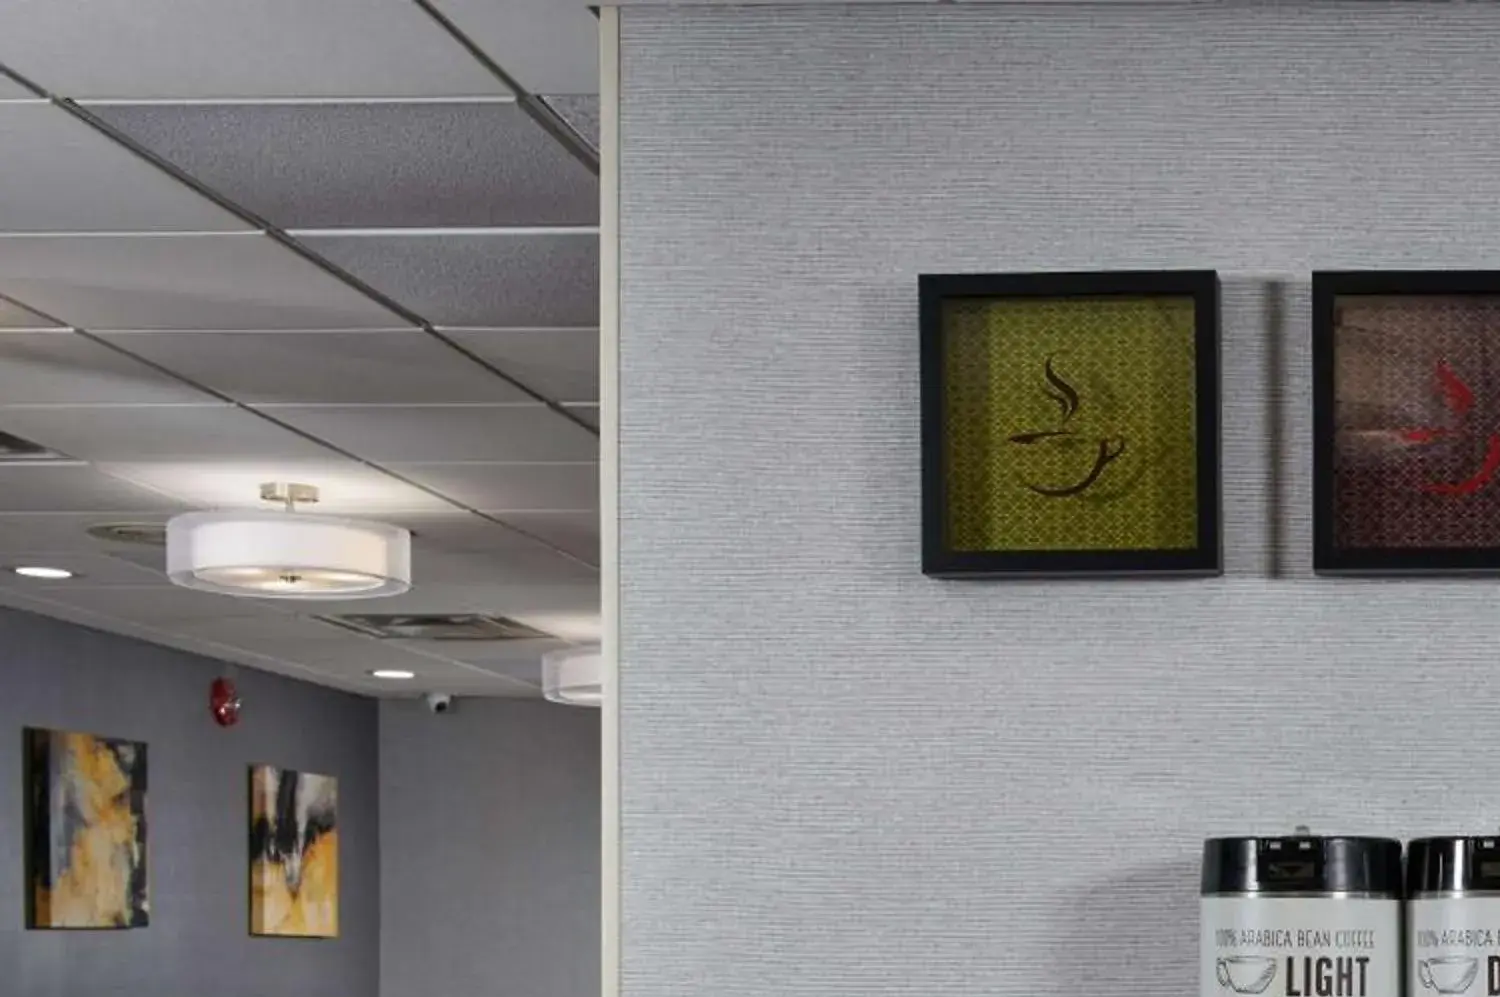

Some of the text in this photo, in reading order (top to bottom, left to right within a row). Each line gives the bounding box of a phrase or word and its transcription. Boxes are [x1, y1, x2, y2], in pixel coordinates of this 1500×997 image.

[1240, 929, 1293, 948] ARABICA
[1297, 929, 1330, 949] BEAN
[1439, 929, 1494, 948] ARABICA
[1286, 955, 1370, 997] LIGHT
